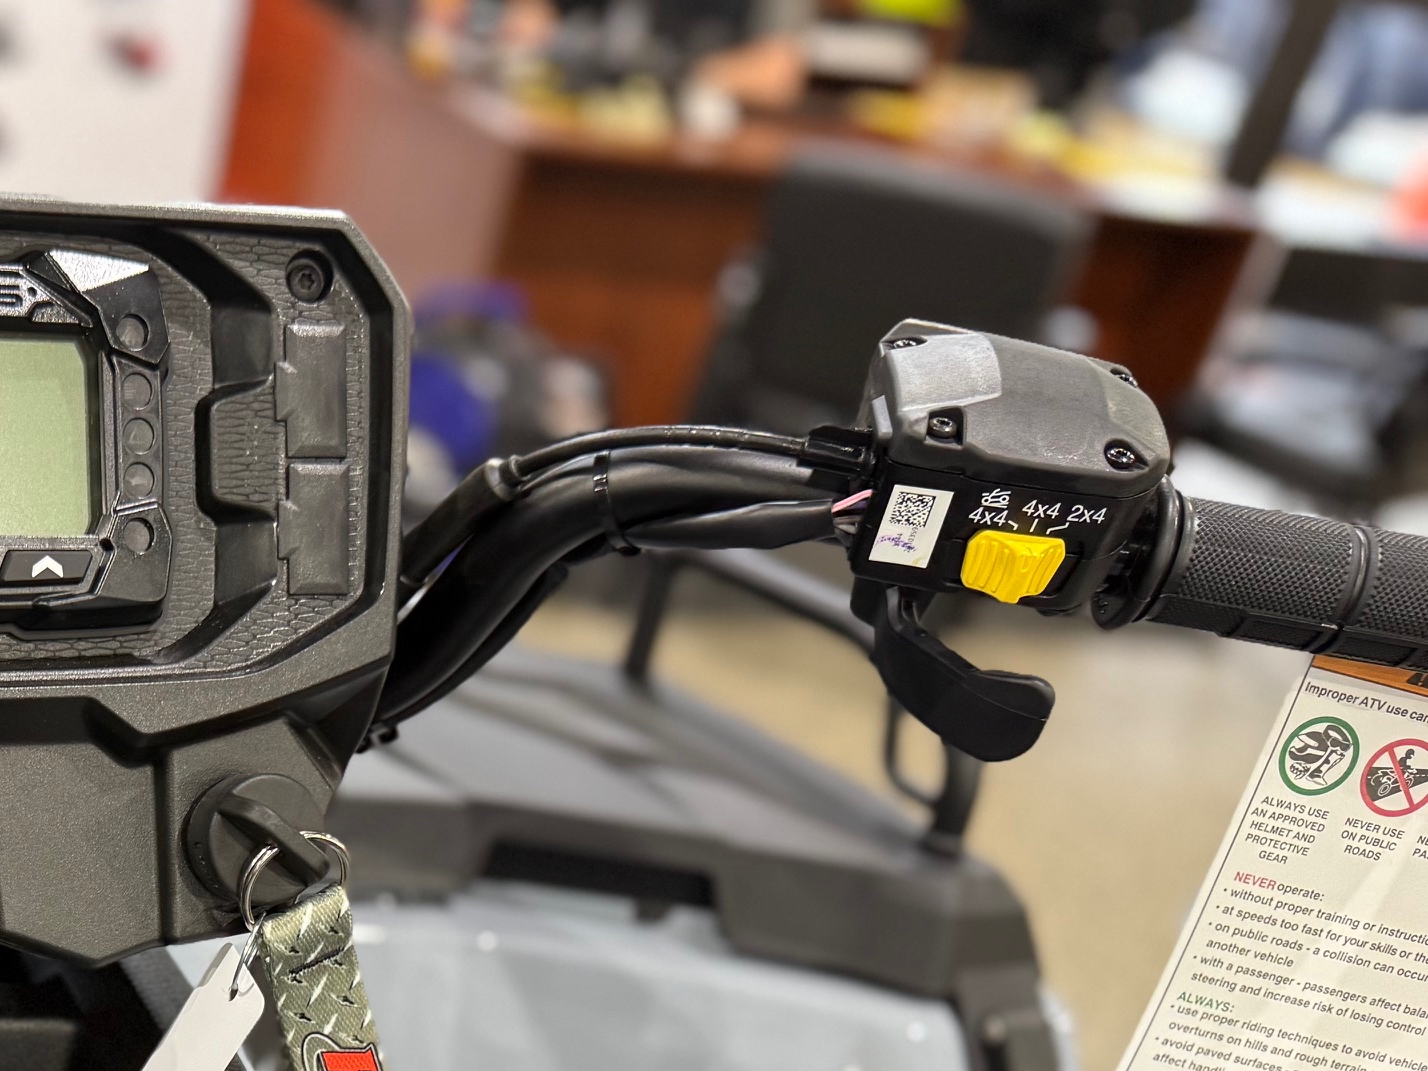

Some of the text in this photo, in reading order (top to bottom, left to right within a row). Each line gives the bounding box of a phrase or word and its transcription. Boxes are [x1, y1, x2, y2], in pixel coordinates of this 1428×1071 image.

[968, 508, 1008, 527] 4x4
[1022, 500, 1108, 525] 4x4 2x4
[1305, 681, 1360, 704] Improper
[1358, 696, 1388, 711] ATV
[1386, 705, 1409, 717] use
[1251, 807, 1325, 832] AN APPROVED
[1261, 796, 1330, 820] ALWAYS USE
[1249, 820, 1316, 844] HELMET AND
[1341, 830, 1397, 851] ON PUBLIC
[1344, 817, 1405, 840] NEVER USE
[1245, 833, 1310, 856] PROTECTIVE
[1343, 844, 1382, 861] ROADS
[1258, 850, 1288, 865] GEAR
[1233, 871, 1325, 902] NEVER operate:
[1230, 889, 1377, 932] without proper training or
[1222, 906, 1413, 959] at speeds too fast for your skills or
[1206, 939, 1294, 967] another vehicle
[1215, 923, 1230, 933] on
[1231, 927, 1269, 942] public
[1270, 937, 1304, 951] roads
[1312, 947, 1321, 955] a
[1323, 950, 1371, 968] collision
[1373, 962, 1395, 974] can
[1200, 956, 1402, 1012] with a passenger passengers affect
[1176, 991, 1235, 1013] ALWAYS:
[1191, 973, 1427, 1036] steering and increase risk of losing control
[1168, 1022, 1224, 1042] overturns
[1226, 1036, 1242, 1046] on
[1244, 1038, 1268, 1052] hills
[1270, 1046, 1294, 1058] and
[1294, 1052, 1328, 1067] rough
[1177, 1005, 1198, 1017] use
[1199, 1012, 1240, 1027] proper
[1241, 1020, 1275, 1038] riding
[1277, 1029, 1339, 1051] techniques
[1341, 1044, 1353, 1054] to
[1354, 1049, 1388, 1063] avoid
[1152, 1053, 1187, 1068] affect
[1161, 1038, 1195, 1052] avoid
[1194, 1047, 1233, 1061] paved
